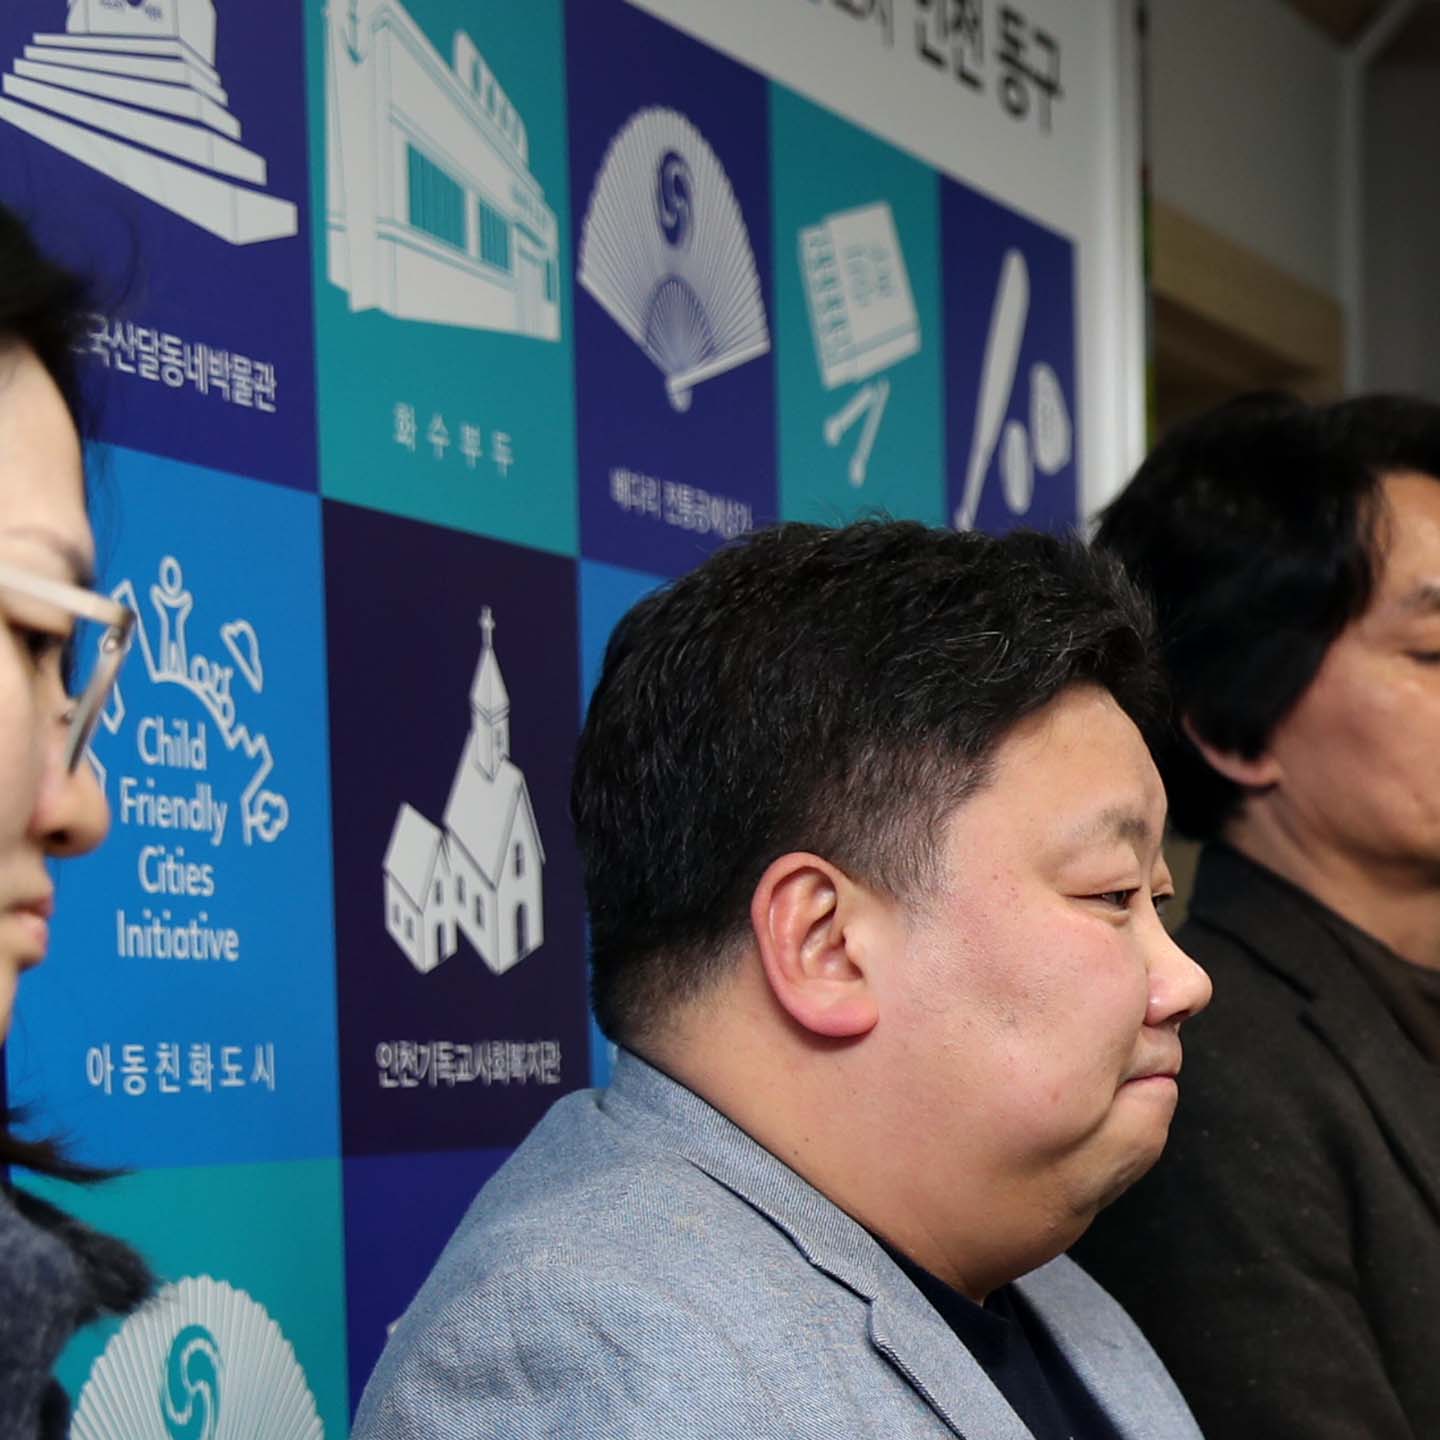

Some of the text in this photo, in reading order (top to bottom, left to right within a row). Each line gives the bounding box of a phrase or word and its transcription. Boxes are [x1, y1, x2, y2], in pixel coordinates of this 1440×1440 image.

[997, 5, 1063, 136] 동구
[73, 312, 277, 413] 국산달동네박물관
[393, 401, 514, 478] 화수부두
[137, 715, 207, 771] Child
[119, 776, 228, 847] Friendly
[138, 845, 215, 898] Cities
[116, 907, 240, 962] Initiative
[86, 1041, 276, 1096] 아동친화도시
[375, 1038, 562, 1089] 인천기독교사회복지관
